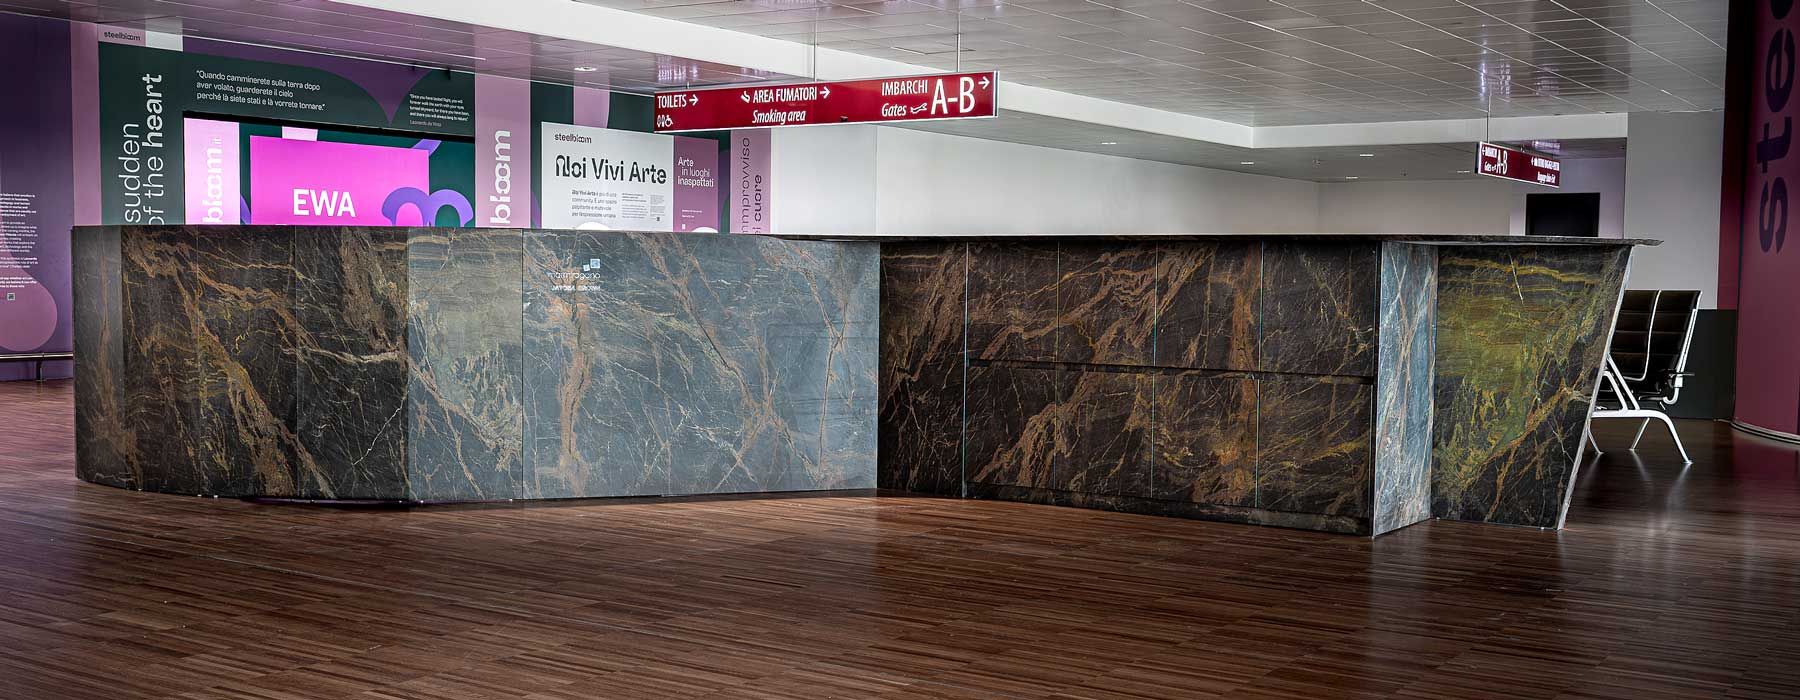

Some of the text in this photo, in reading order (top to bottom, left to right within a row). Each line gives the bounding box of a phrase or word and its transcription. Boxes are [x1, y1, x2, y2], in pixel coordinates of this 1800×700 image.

[104, 32, 140, 40] steelbloom
[214, 82, 235, 92] volato,
[236, 86, 272, 96] guarderete
[279, 89, 293, 98] cielo
[227, 74, 270, 85] camminerete
[304, 82, 320, 91] dopo
[881, 80, 928, 96] IMBARCHI
[197, 92, 221, 100] perché
[247, 96, 260, 104] stati
[274, 100, 298, 108] vorrete
[658, 94, 687, 108] TOILETS
[752, 86, 817, 103] AREA FUMATORI
[930, 76, 975, 114] A-B
[142, 73, 163, 148] heart
[752, 109, 806, 125] Smoking area
[882, 103, 906, 116] Gates
[1757, 0, 1796, 253] ste
[554, 134, 592, 143] steelbloom
[678, 157, 693, 166] Arte
[1496, 149, 1507, 174] A-B
[118, 123, 141, 223] sudden
[143, 156, 164, 198] the
[592, 158, 624, 181] Vivi
[629, 161, 666, 184] Arte
[682, 167, 710, 178] in luoghi
[678, 176, 714, 188] inaspettati
[293, 188, 356, 217] EWA
